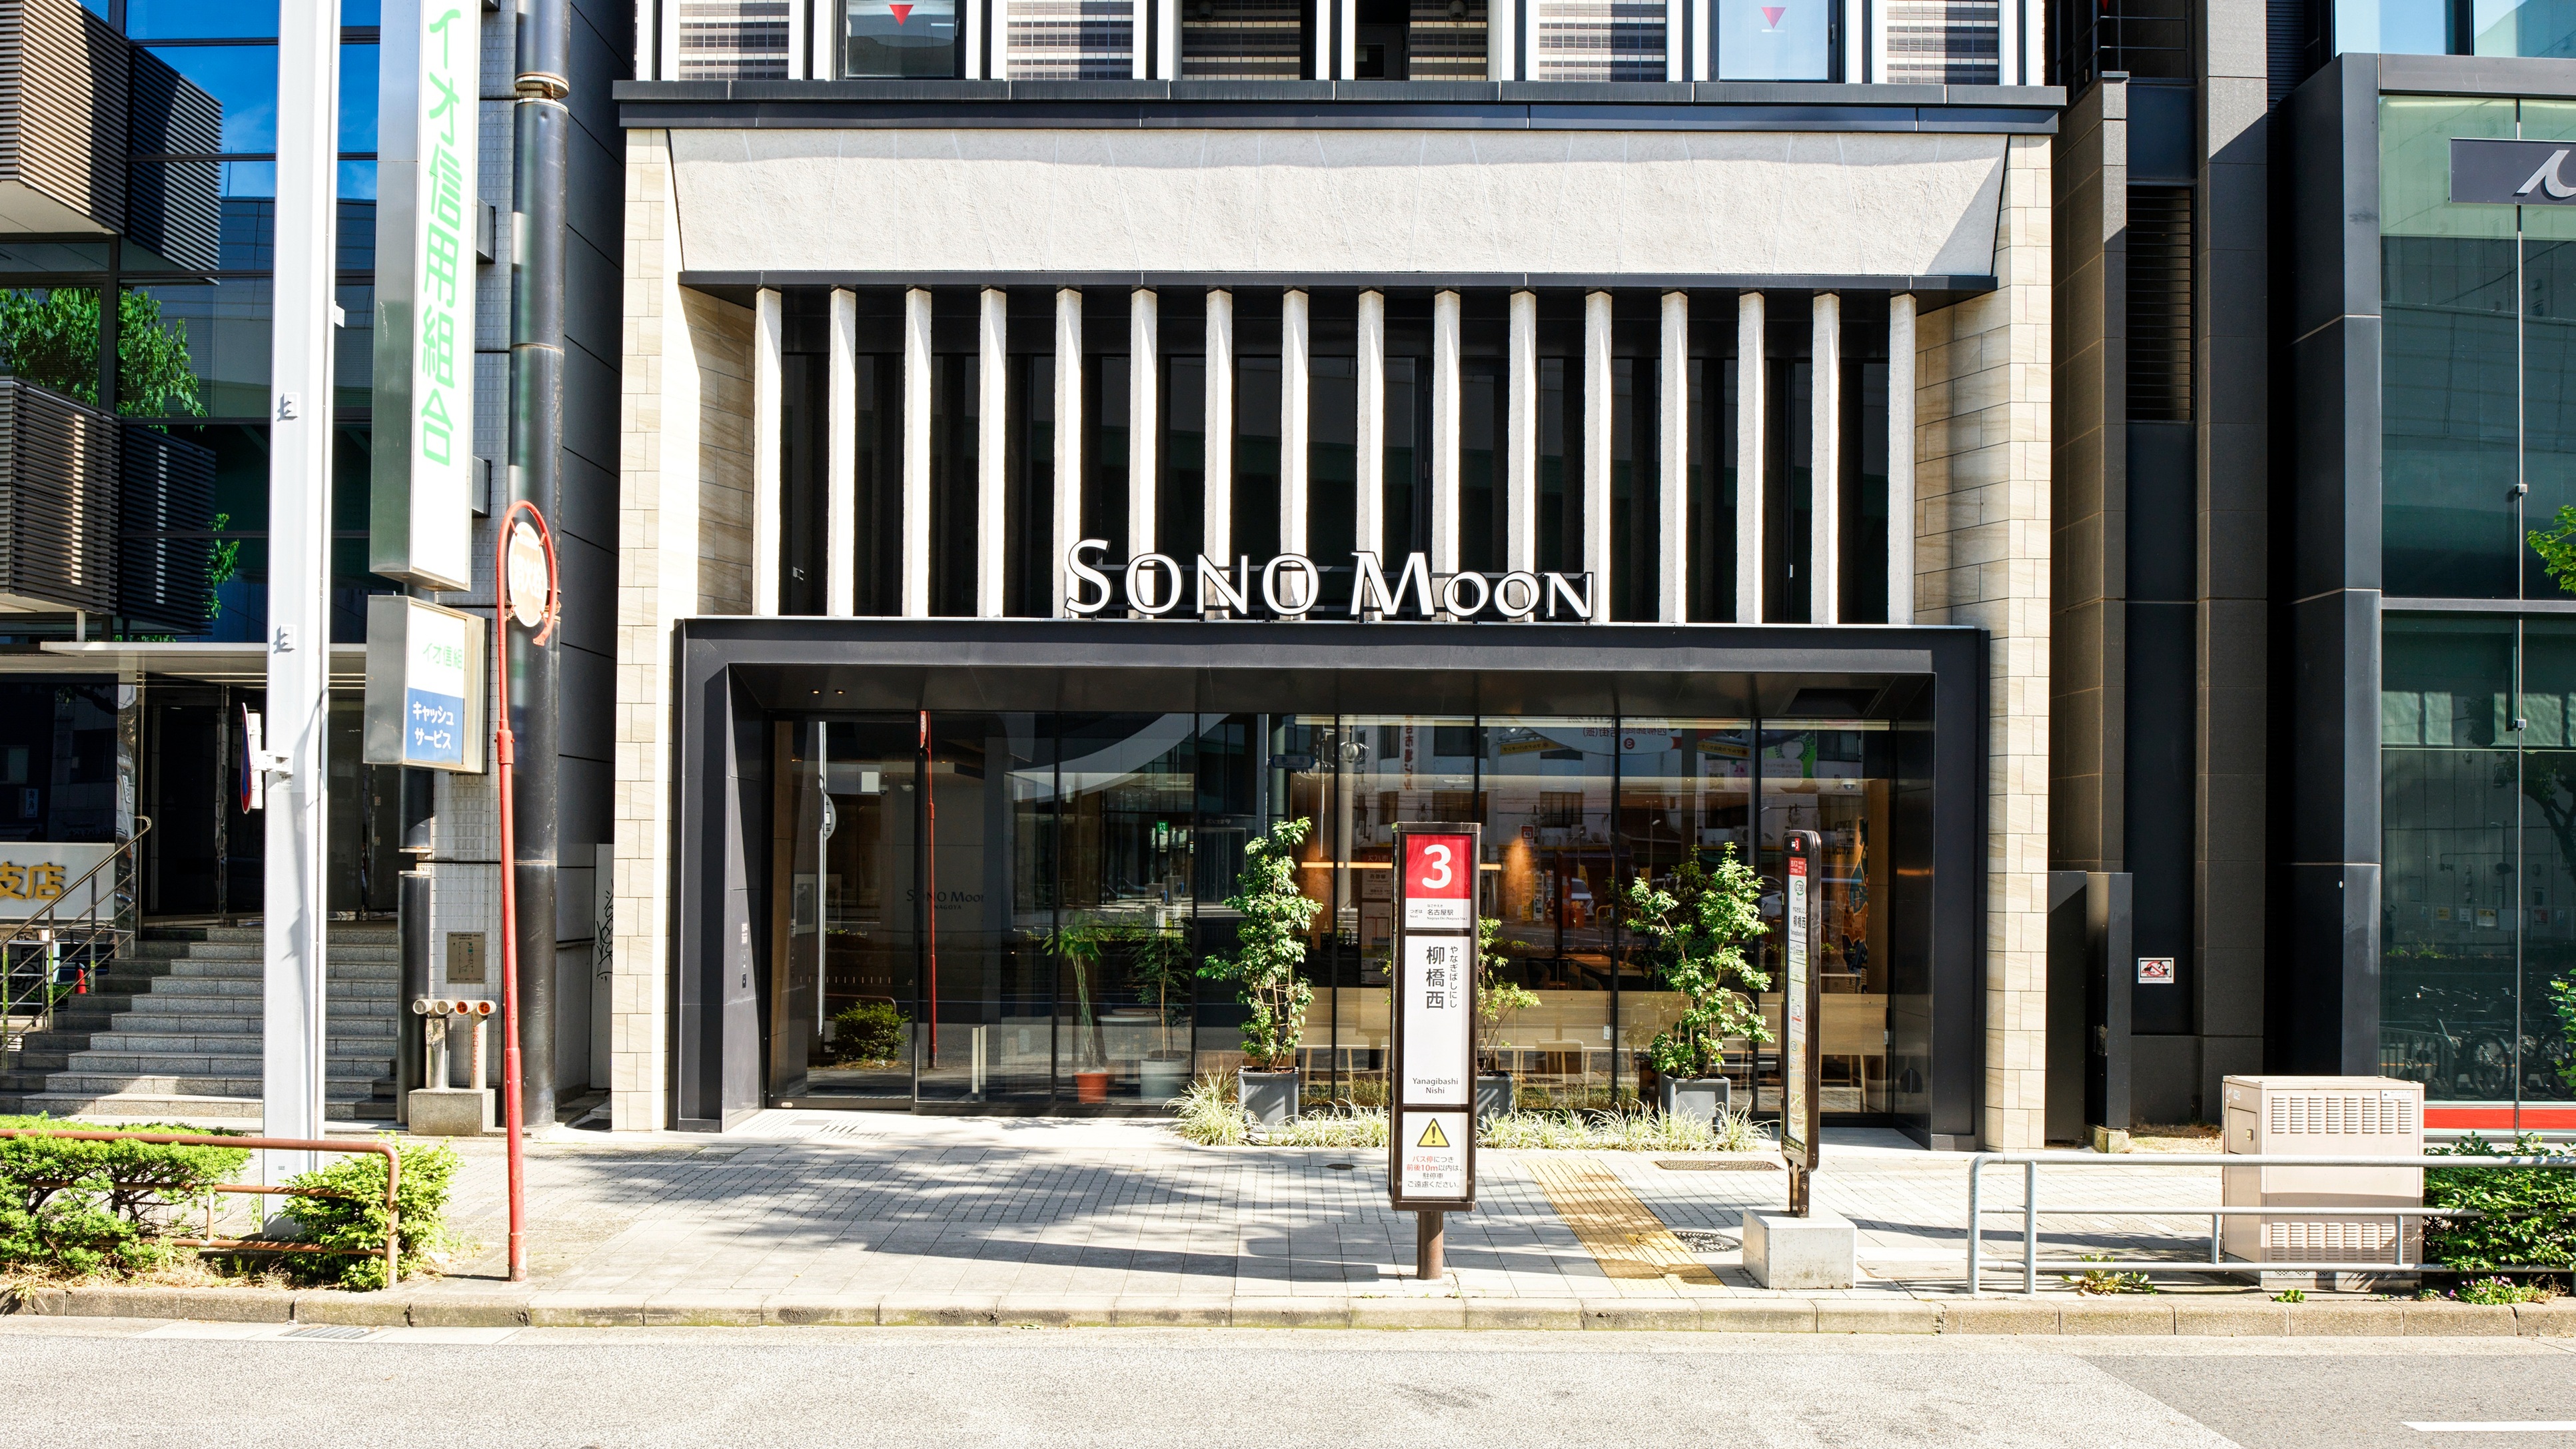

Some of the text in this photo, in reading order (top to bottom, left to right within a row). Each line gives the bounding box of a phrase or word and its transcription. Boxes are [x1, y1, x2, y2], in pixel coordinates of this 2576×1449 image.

[422, 9, 462, 467] イオ信用組合
[1065, 538, 1595, 619] SONO Moon
[422, 643, 462, 670] イオ信組
[412, 701, 454, 726] キャッシュ
[414, 727, 451, 749] サービス
[1795, 840, 1799, 849] 3
[1422, 844, 1452, 889] 3
[906, 889, 946, 902] SNO
[1426, 946, 1445, 1009] 柳橋西
[1449, 946, 1459, 1008] やなぎばしにし
[1413, 1077, 1459, 1086] Yanagibashi
